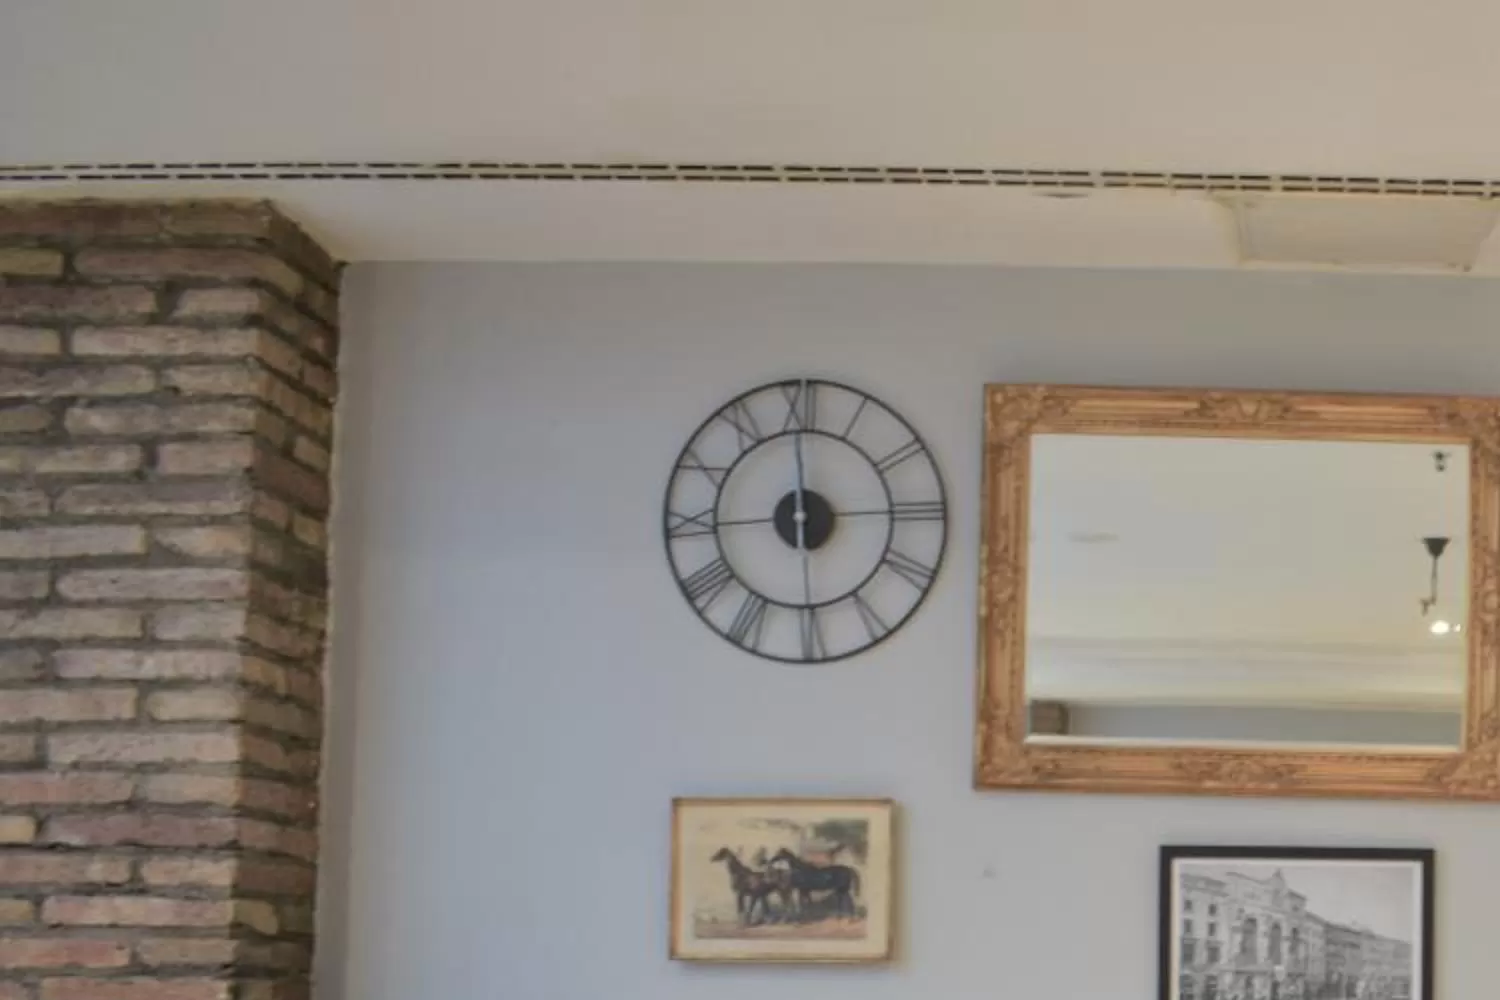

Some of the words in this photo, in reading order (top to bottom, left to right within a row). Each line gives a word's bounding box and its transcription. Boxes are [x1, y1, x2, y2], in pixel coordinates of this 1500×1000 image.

[720, 400, 761, 450] XI
[781, 383, 817, 431] XII
[677, 450, 732, 487] X
[875, 438, 925, 472] II
[669, 509, 718, 538] IX
[893, 501, 945, 521] III
[682, 558, 735, 613] VIII
[884, 550, 936, 591] IV
[727, 594, 767, 650] VII
[800, 608, 827, 660] VI
[854, 594, 889, 641] V
